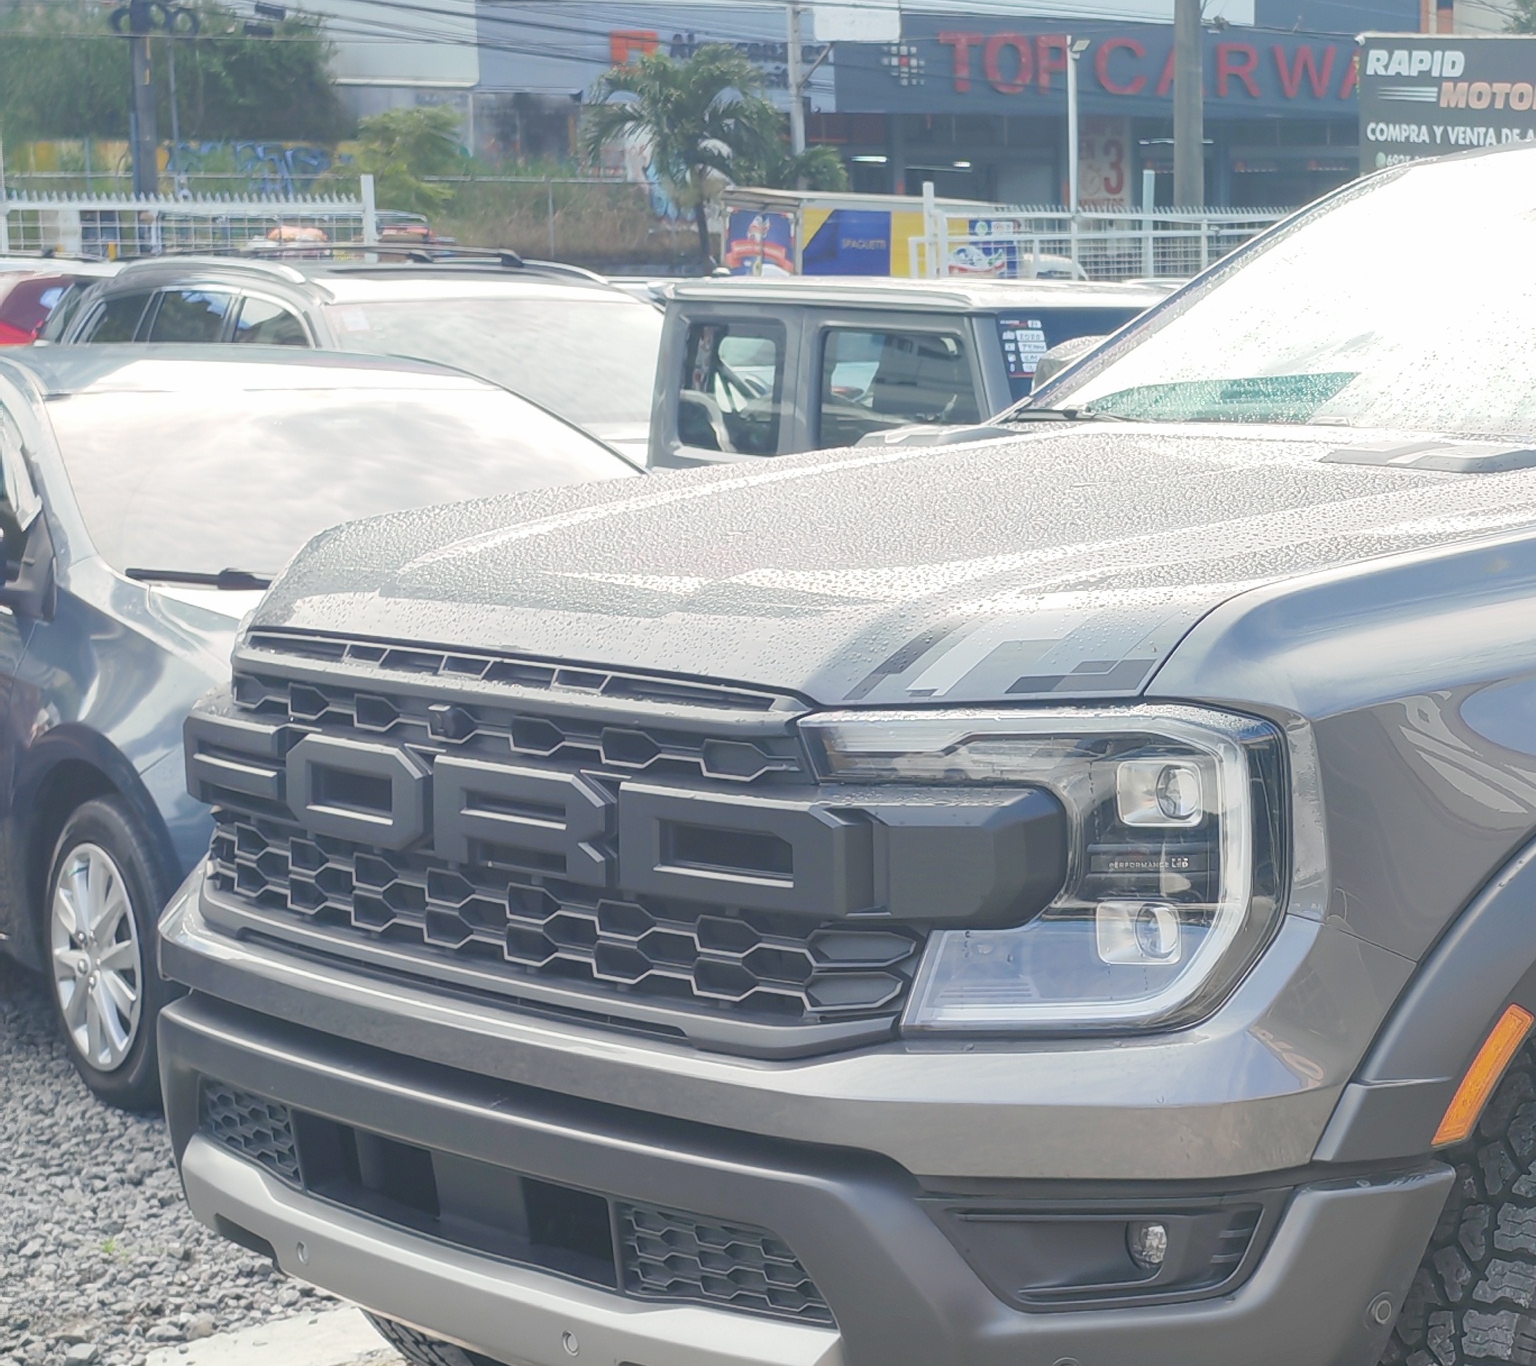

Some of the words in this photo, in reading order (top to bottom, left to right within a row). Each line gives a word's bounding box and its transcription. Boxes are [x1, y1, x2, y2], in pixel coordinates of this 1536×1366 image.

[938, 32, 1070, 95] TOP
[1366, 49, 1465, 77] RAPID
[1366, 122, 1430, 144] COMPRA
[1433, 125, 1444, 145] Y
[1448, 126, 1497, 146] VENTA
[1103, 139, 1124, 194] 3
[185, 711, 872, 917] FORD
